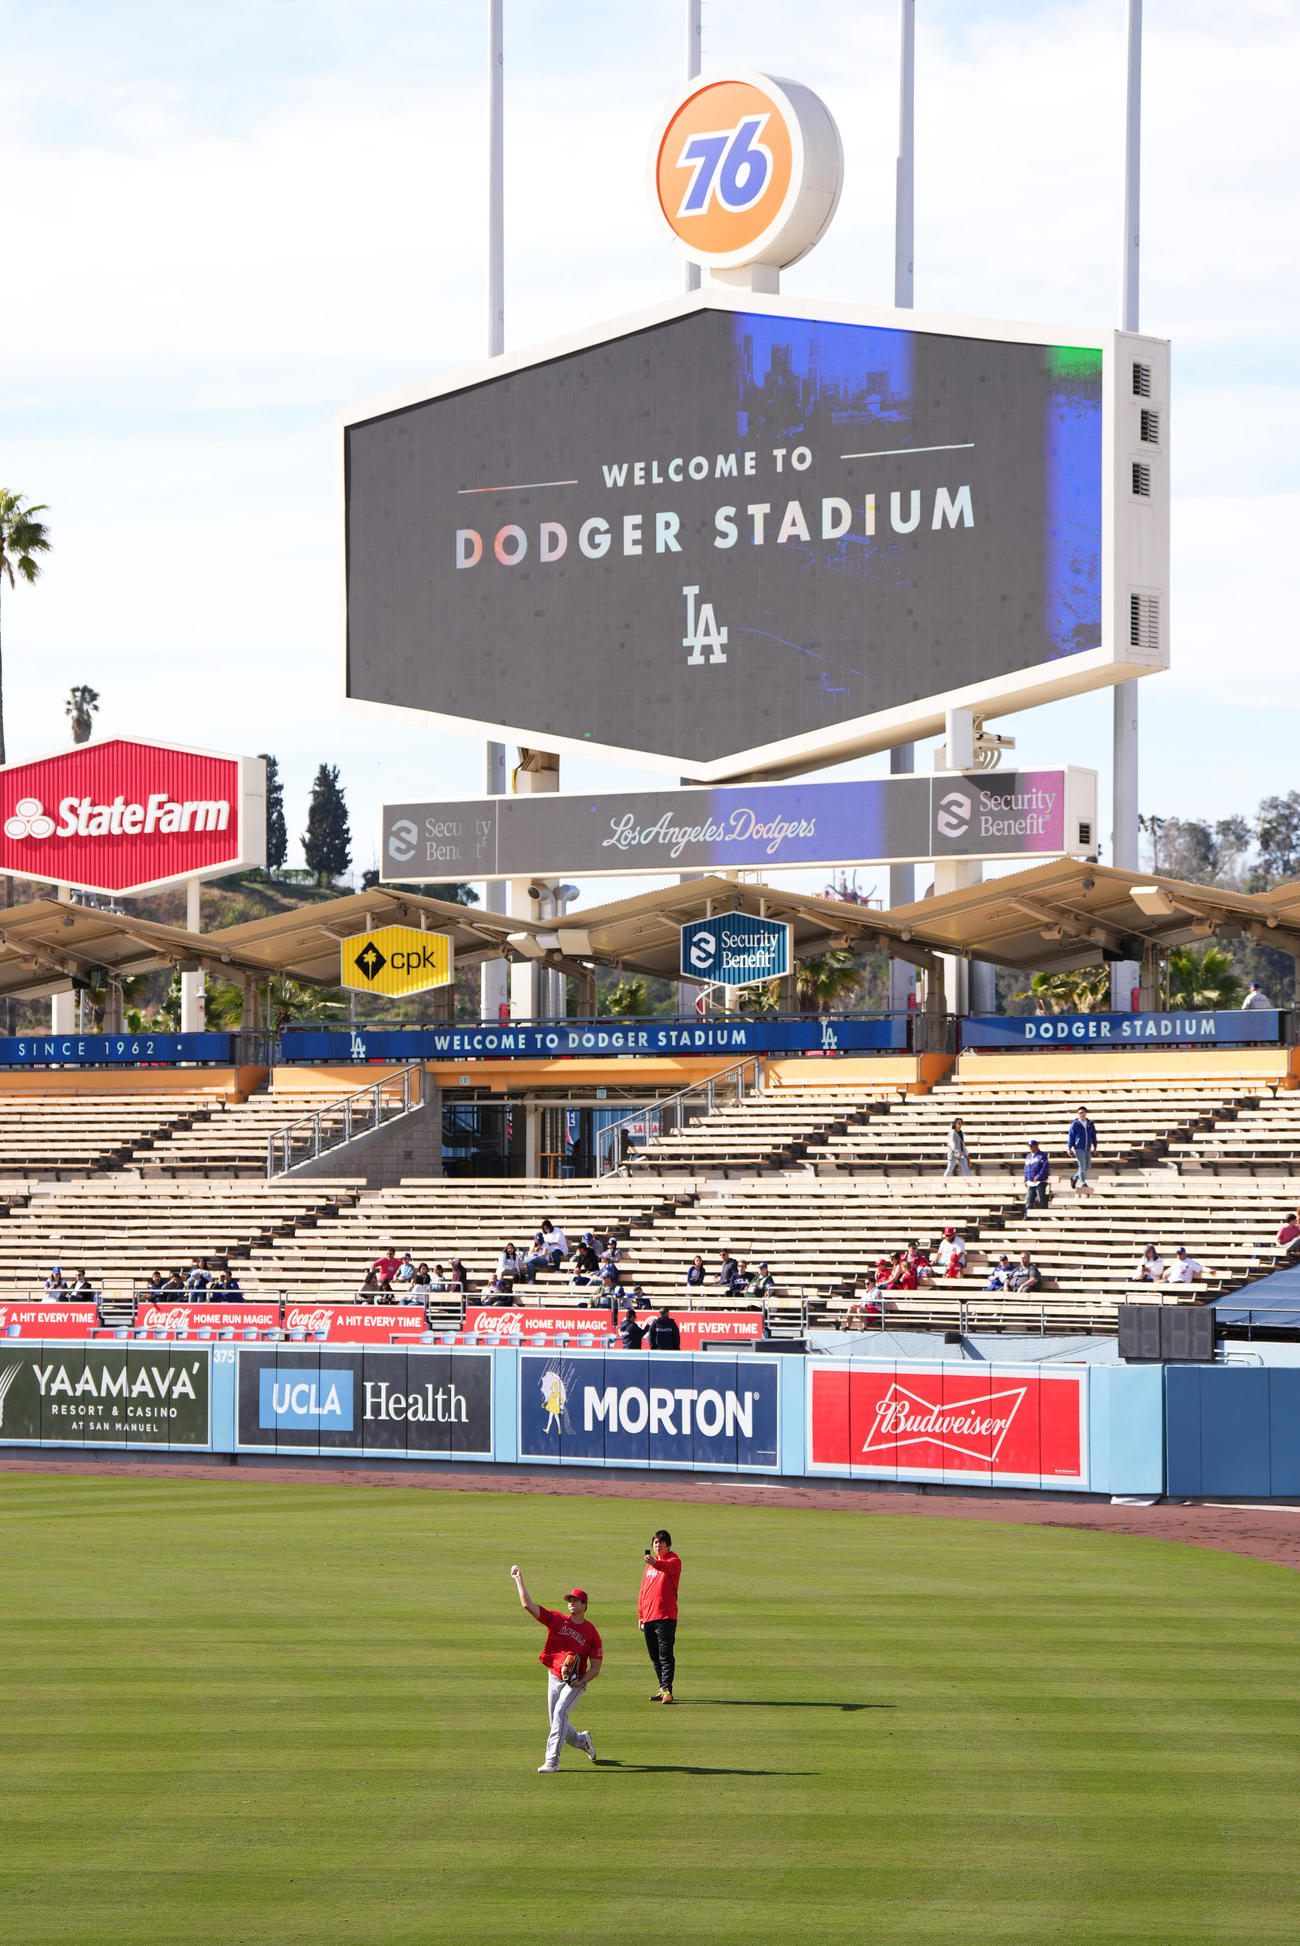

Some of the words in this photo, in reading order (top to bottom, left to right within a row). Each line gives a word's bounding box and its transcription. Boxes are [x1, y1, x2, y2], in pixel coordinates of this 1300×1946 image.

[675, 113, 774, 218] 76
[602, 451, 757, 489] WELCOME
[773, 446, 813, 472] TO
[455, 511, 683, 569] DODGER
[713, 485, 976, 549] STADIUM
[682, 585, 729, 666] LA
[979, 788, 1056, 814] Security
[425, 817, 492, 840] Secuty
[602, 813, 640, 850] Los
[640, 811, 725, 859] Angeles
[725, 808, 816, 855] Dodgers
[721, 929, 779, 951] Security
[390, 945, 436, 976] cpk
[434, 1034, 526, 1050] WELCOME
[535, 1033, 559, 1049] TO
[568, 1031, 648, 1048] DODGER
[658, 1029, 747, 1046] STADIUM
[821, 1021, 838, 1049] LA
[1025, 1021, 1111, 1039] DODGER
[1122, 1018, 1216, 1037] STADIUM
[18, 1041, 85, 1056] SINCE
[104, 1041, 154, 1055] 1962
[350, 1031, 366, 1058] LA
[11, 1312, 18, 1322] A
[20, 1312, 36, 1323] HIT
[38, 1313, 69, 1323] EVERY
[70, 1313, 95, 1323] TIME
[193, 1314, 220, 1324] HOME
[222, 1315, 241, 1324] RUN
[243, 1315, 273, 1325] MAGIC
[336, 1317, 344, 1326] A
[345, 1317, 362, 1326] HIT
[364, 1317, 396, 1327] EVERY
[397, 1317, 422, 1328] TIME
[525, 1319, 554, 1329] HOME
[557, 1320, 576, 1330] RUN
[578, 1320, 608, 1331] MAGIC
[680, 1322, 694, 1333] HIT
[697, 1322, 732, 1334] EVERY
[733, 1323, 759, 1334] TIME
[213, 1350, 236, 1363] 375
[52, 1404, 104, 1417] RESORT
[112, 1407, 119, 1416] &
[127, 1406, 178, 1418] CASINO
[272, 1383, 342, 1416] UCLA
[363, 1381, 469, 1423] Health
[72, 1422, 84, 1430] AT
[89, 1422, 110, 1431] SAN
[115, 1423, 159, 1432] MANUEL
[875, 1400, 1009, 1436] Budweiser
